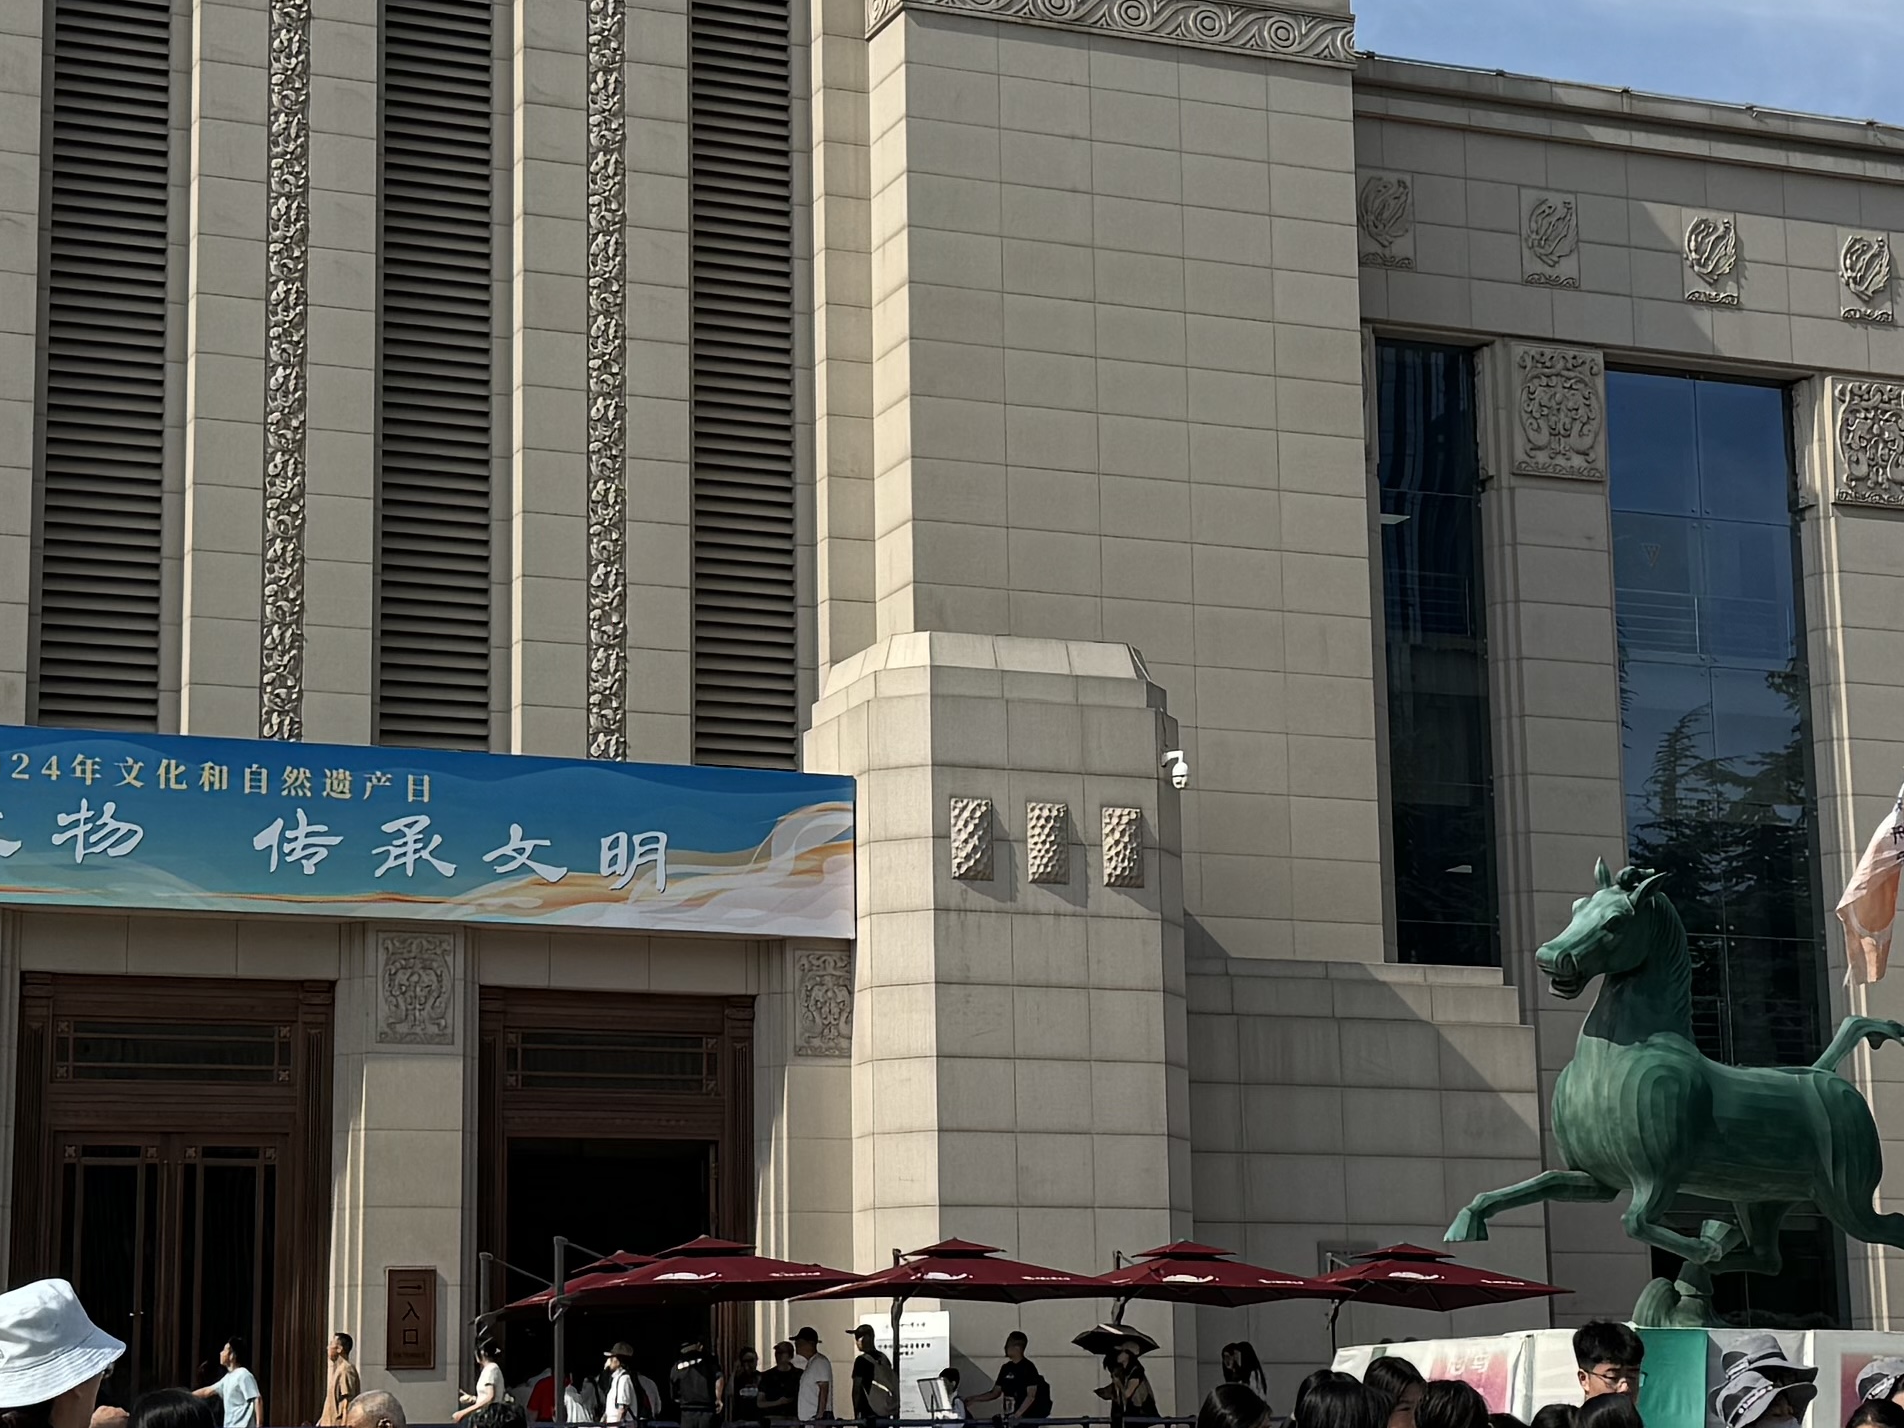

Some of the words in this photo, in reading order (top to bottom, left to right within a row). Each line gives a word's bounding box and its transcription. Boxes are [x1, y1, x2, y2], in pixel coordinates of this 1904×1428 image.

[252, 808, 669, 893] 传承文明
[401, 1300, 420, 1345] 入口
